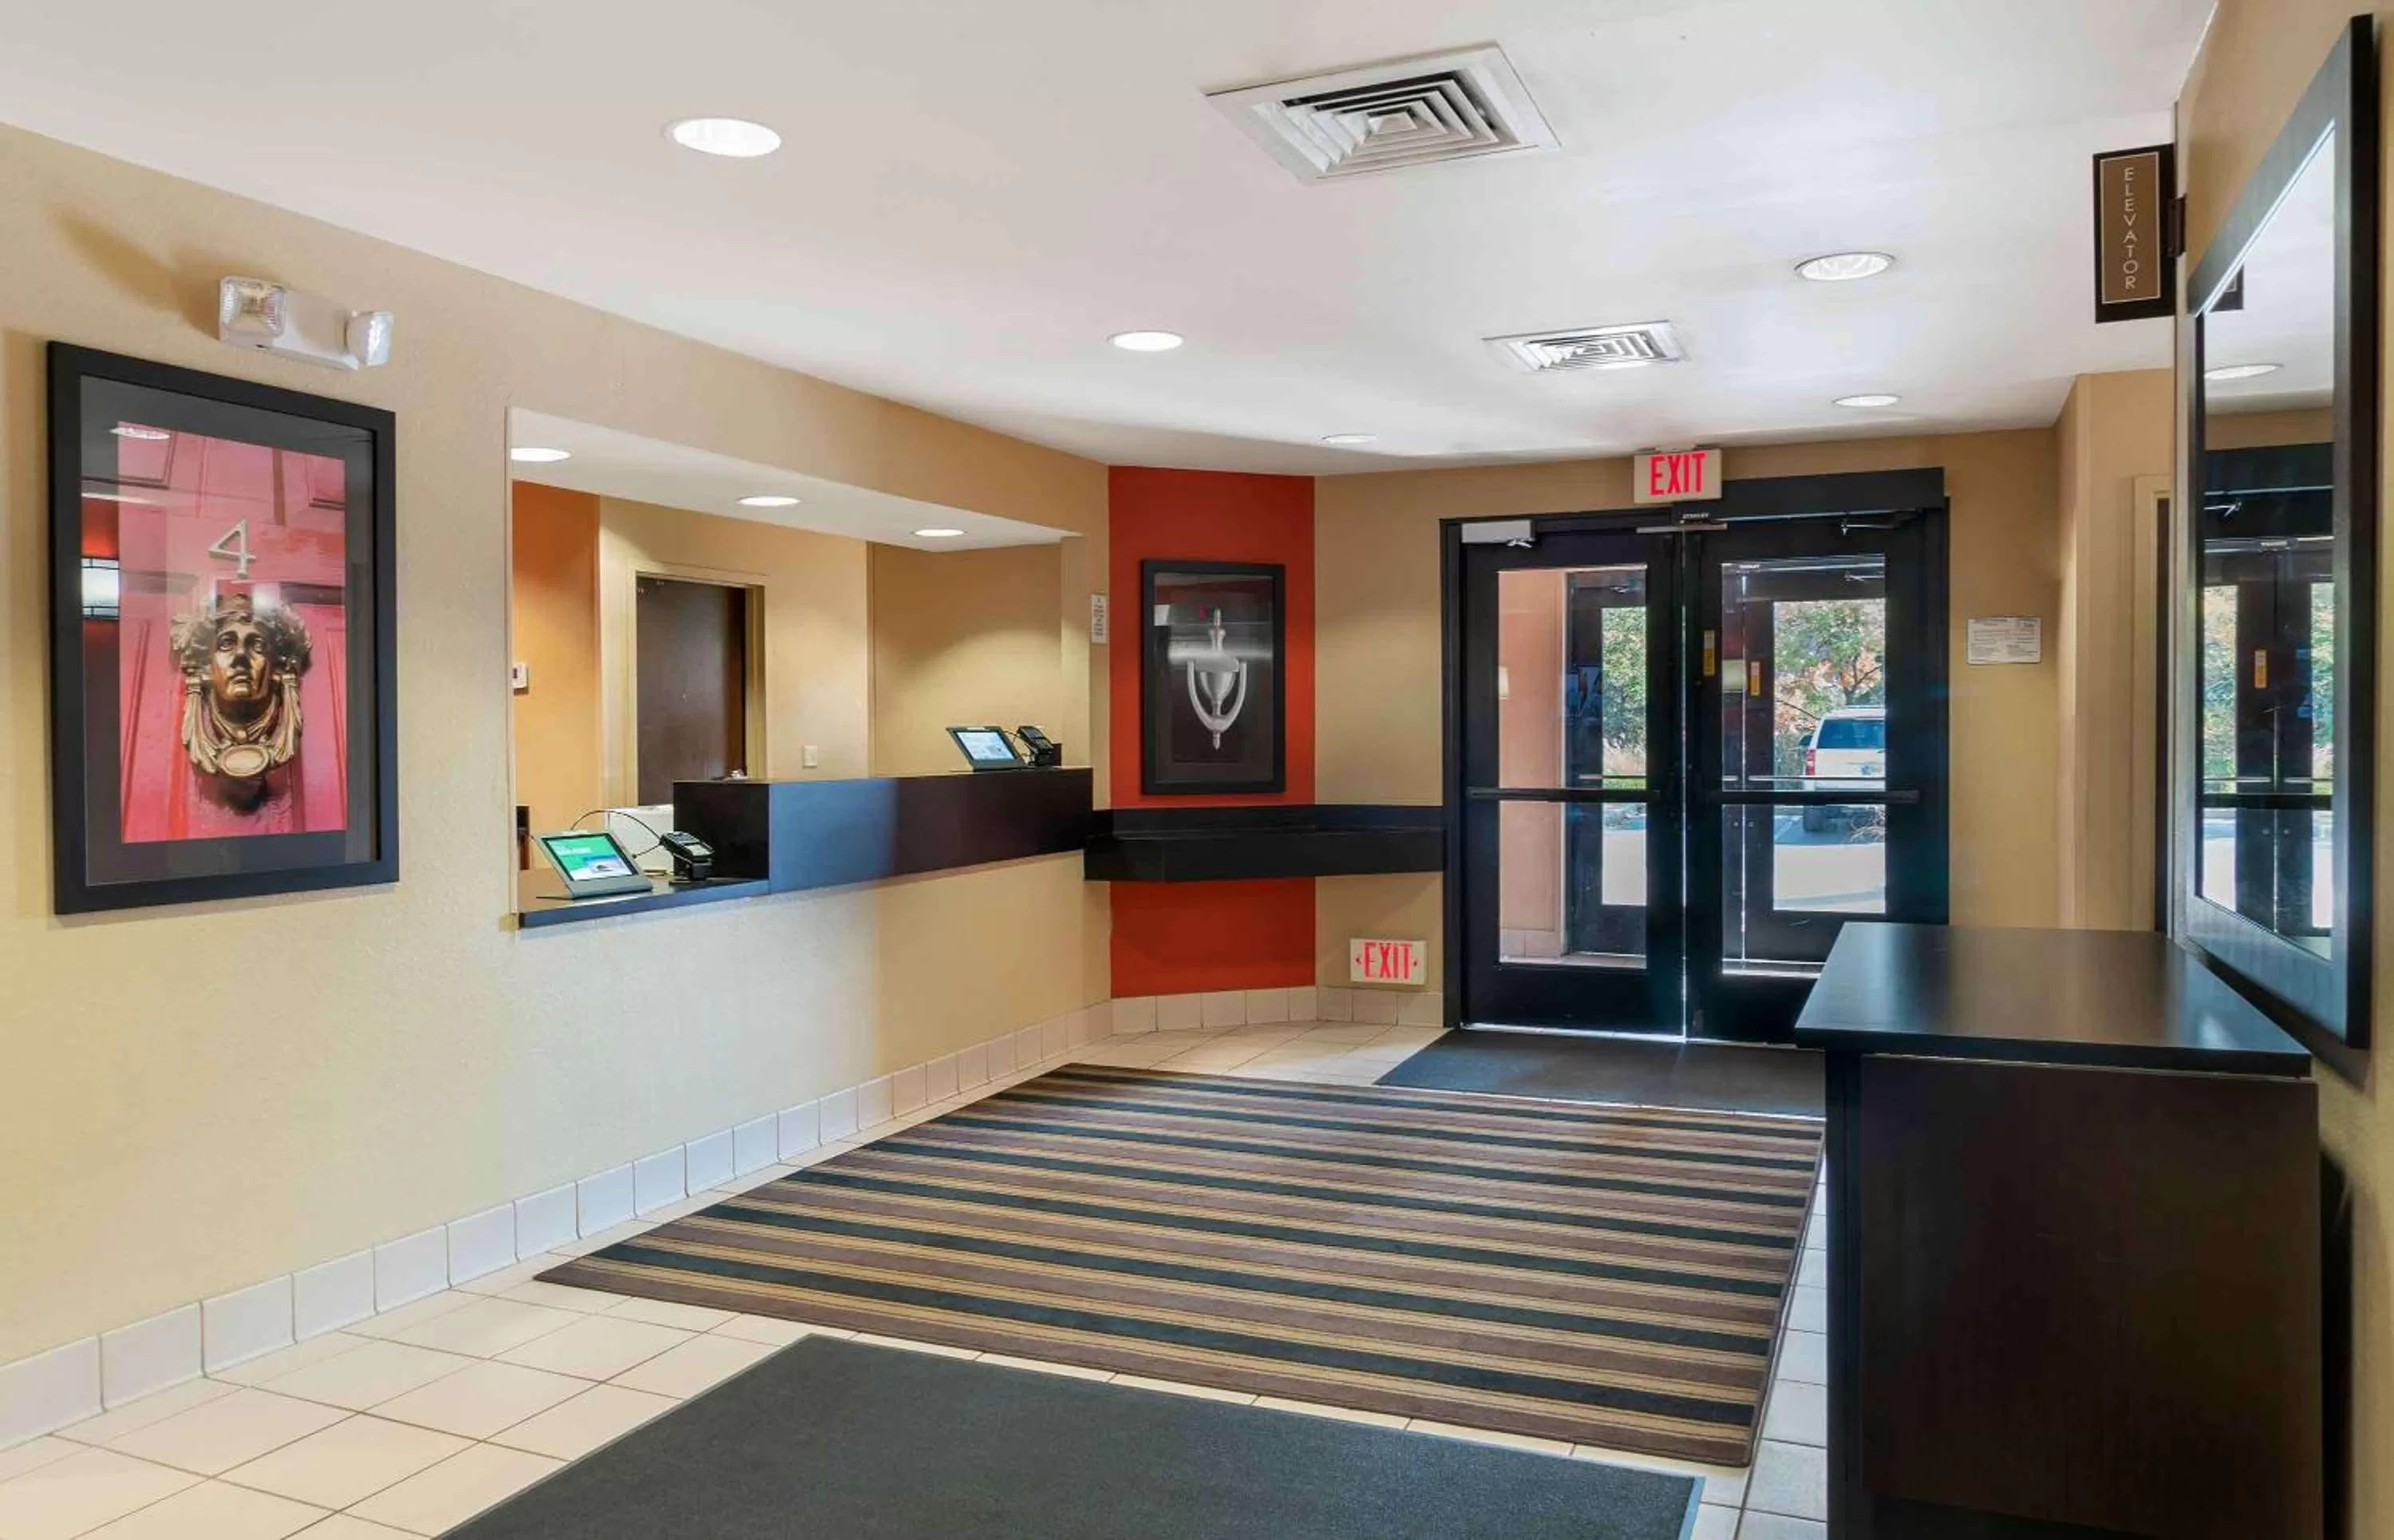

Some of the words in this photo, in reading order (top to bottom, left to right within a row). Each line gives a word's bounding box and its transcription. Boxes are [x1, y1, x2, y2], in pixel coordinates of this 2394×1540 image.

[2123, 168, 2139, 290] ELEVATOR
[1649, 452, 1706, 496] EXIT
[209, 519, 256, 579] 4
[1365, 942, 1412, 980] EXIT
